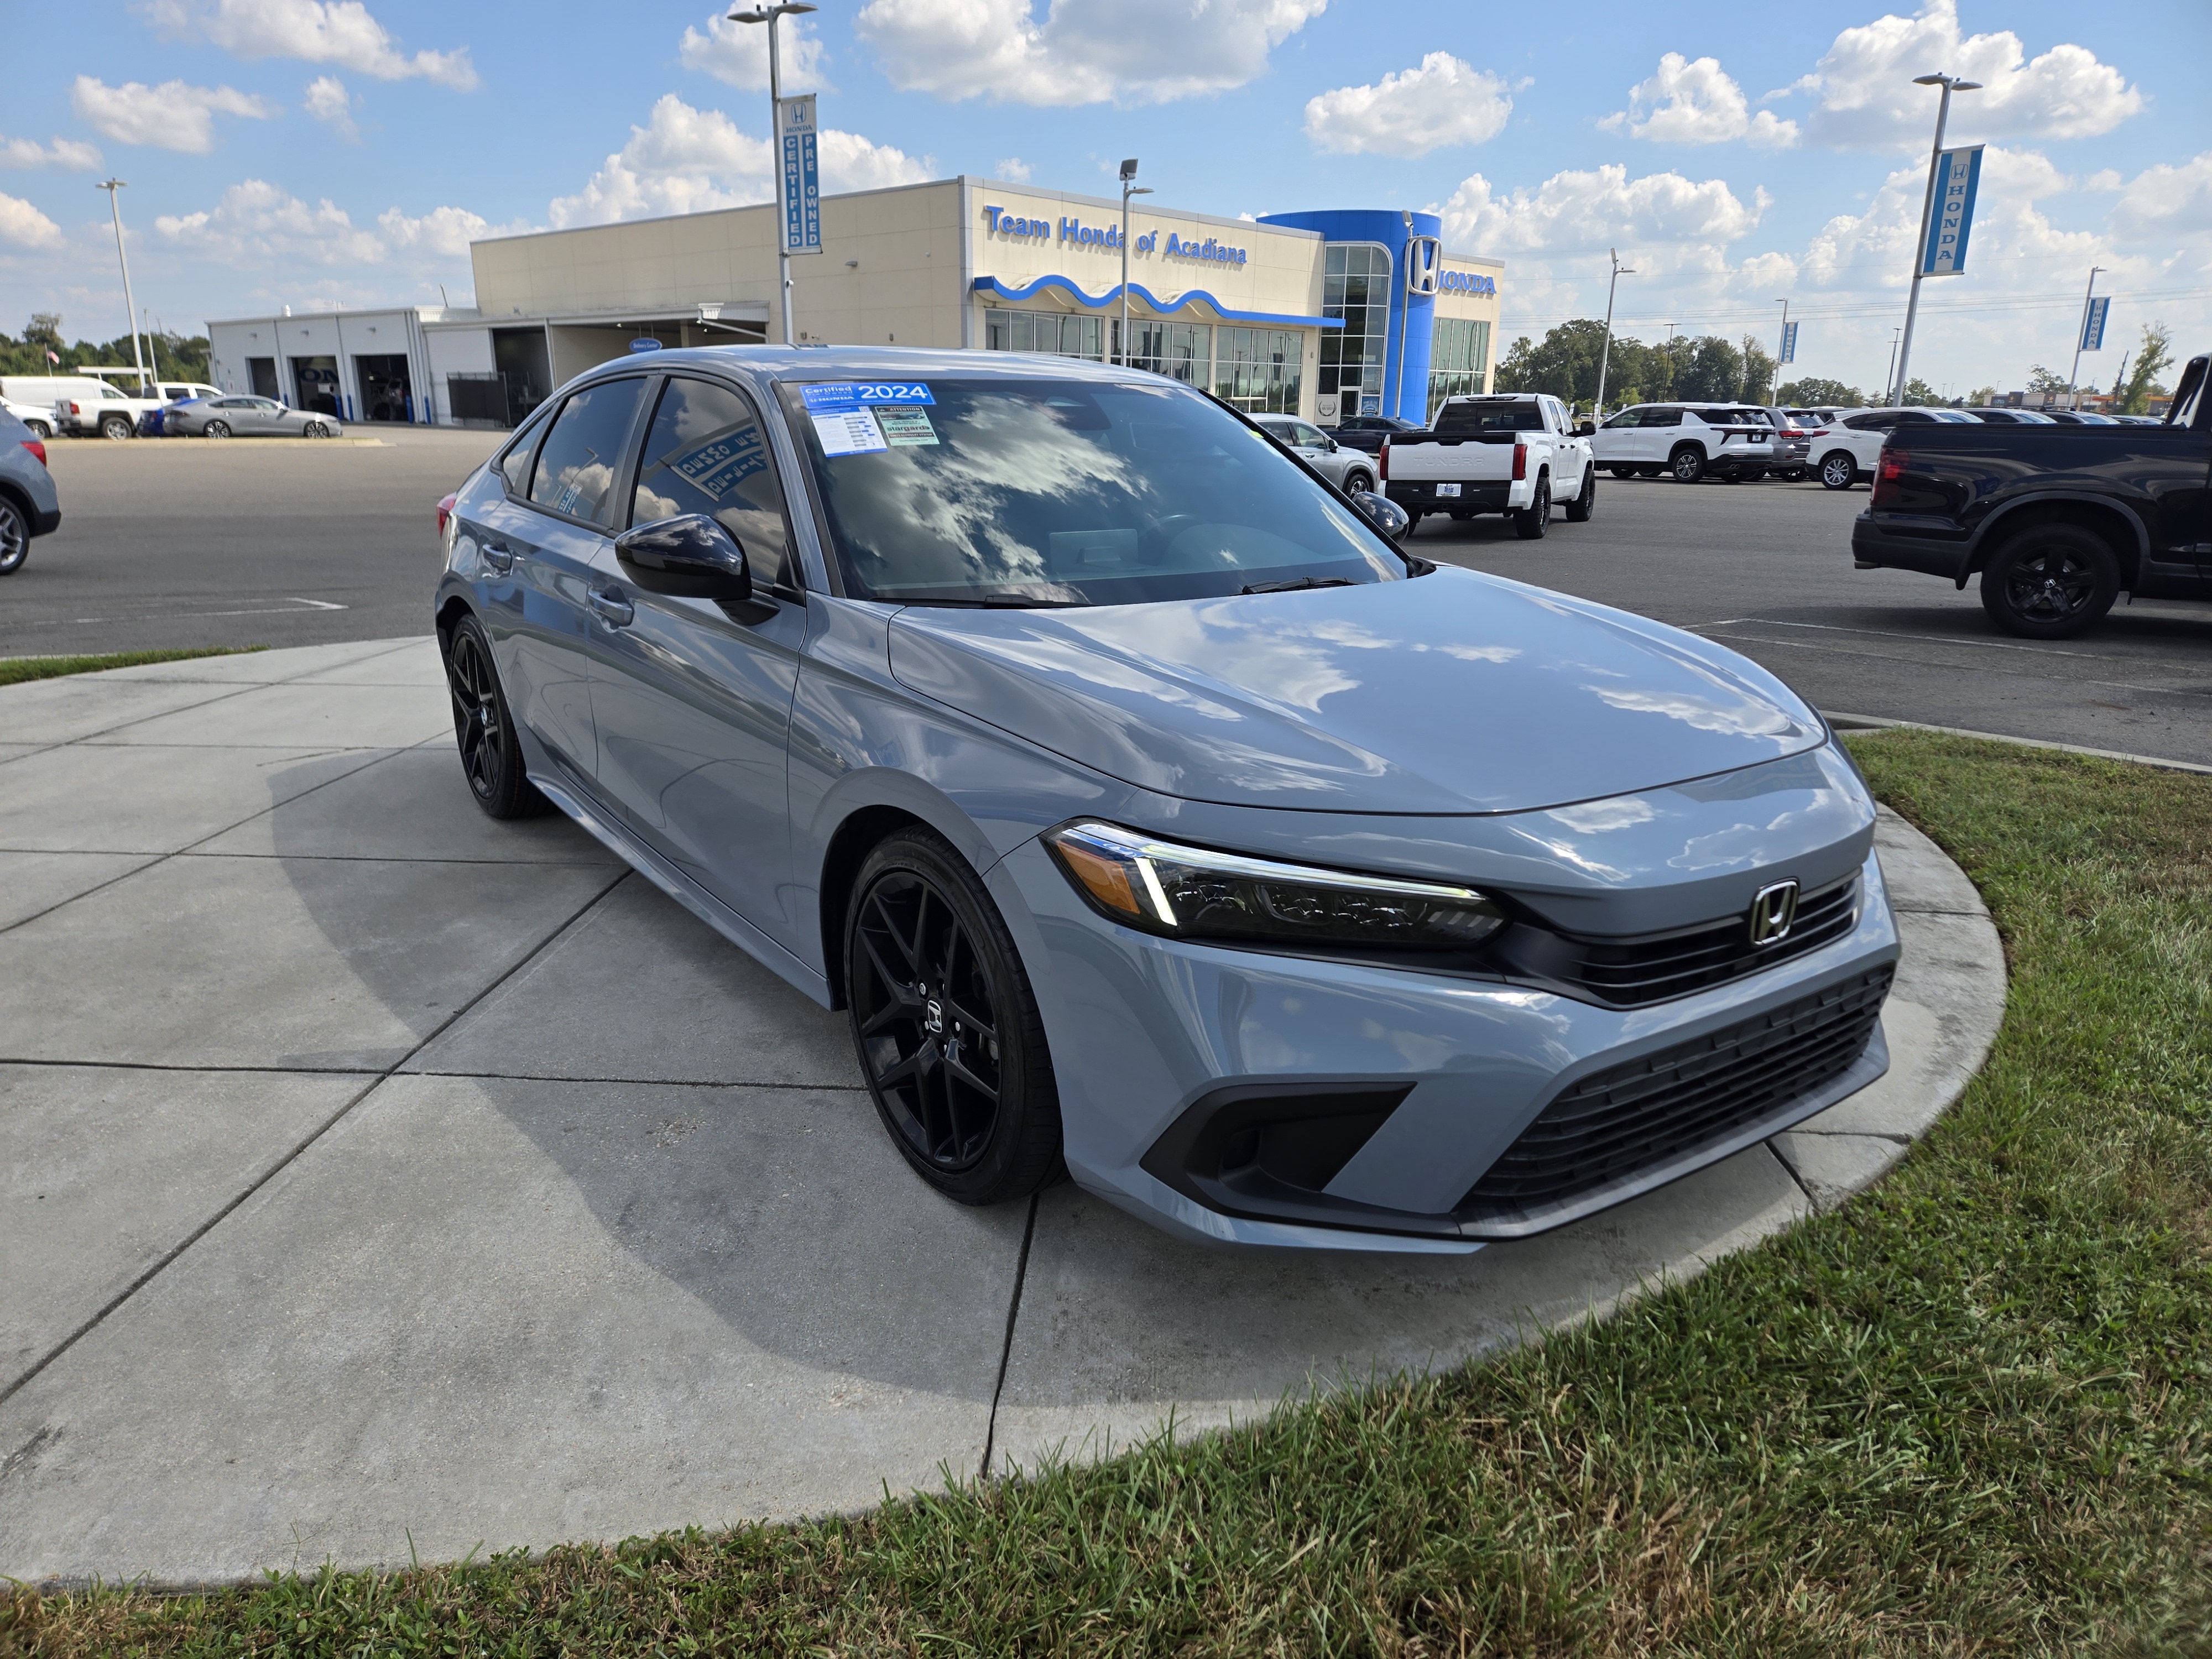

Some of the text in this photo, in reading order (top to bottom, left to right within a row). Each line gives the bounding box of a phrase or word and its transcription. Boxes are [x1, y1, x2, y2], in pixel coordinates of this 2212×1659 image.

[786, 124, 813, 133] HONDA
[786, 138, 800, 246] CERTIFIED
[805, 136, 817, 244] PRE OWNED
[984, 205, 1050, 238] Team
[1138, 229, 1158, 252] of
[1165, 233, 1247, 264] Acadiana
[1938, 185, 1964, 260] HONDA
[2088, 313, 2101, 344] HONDA
[858, 385, 928, 399] 2024
